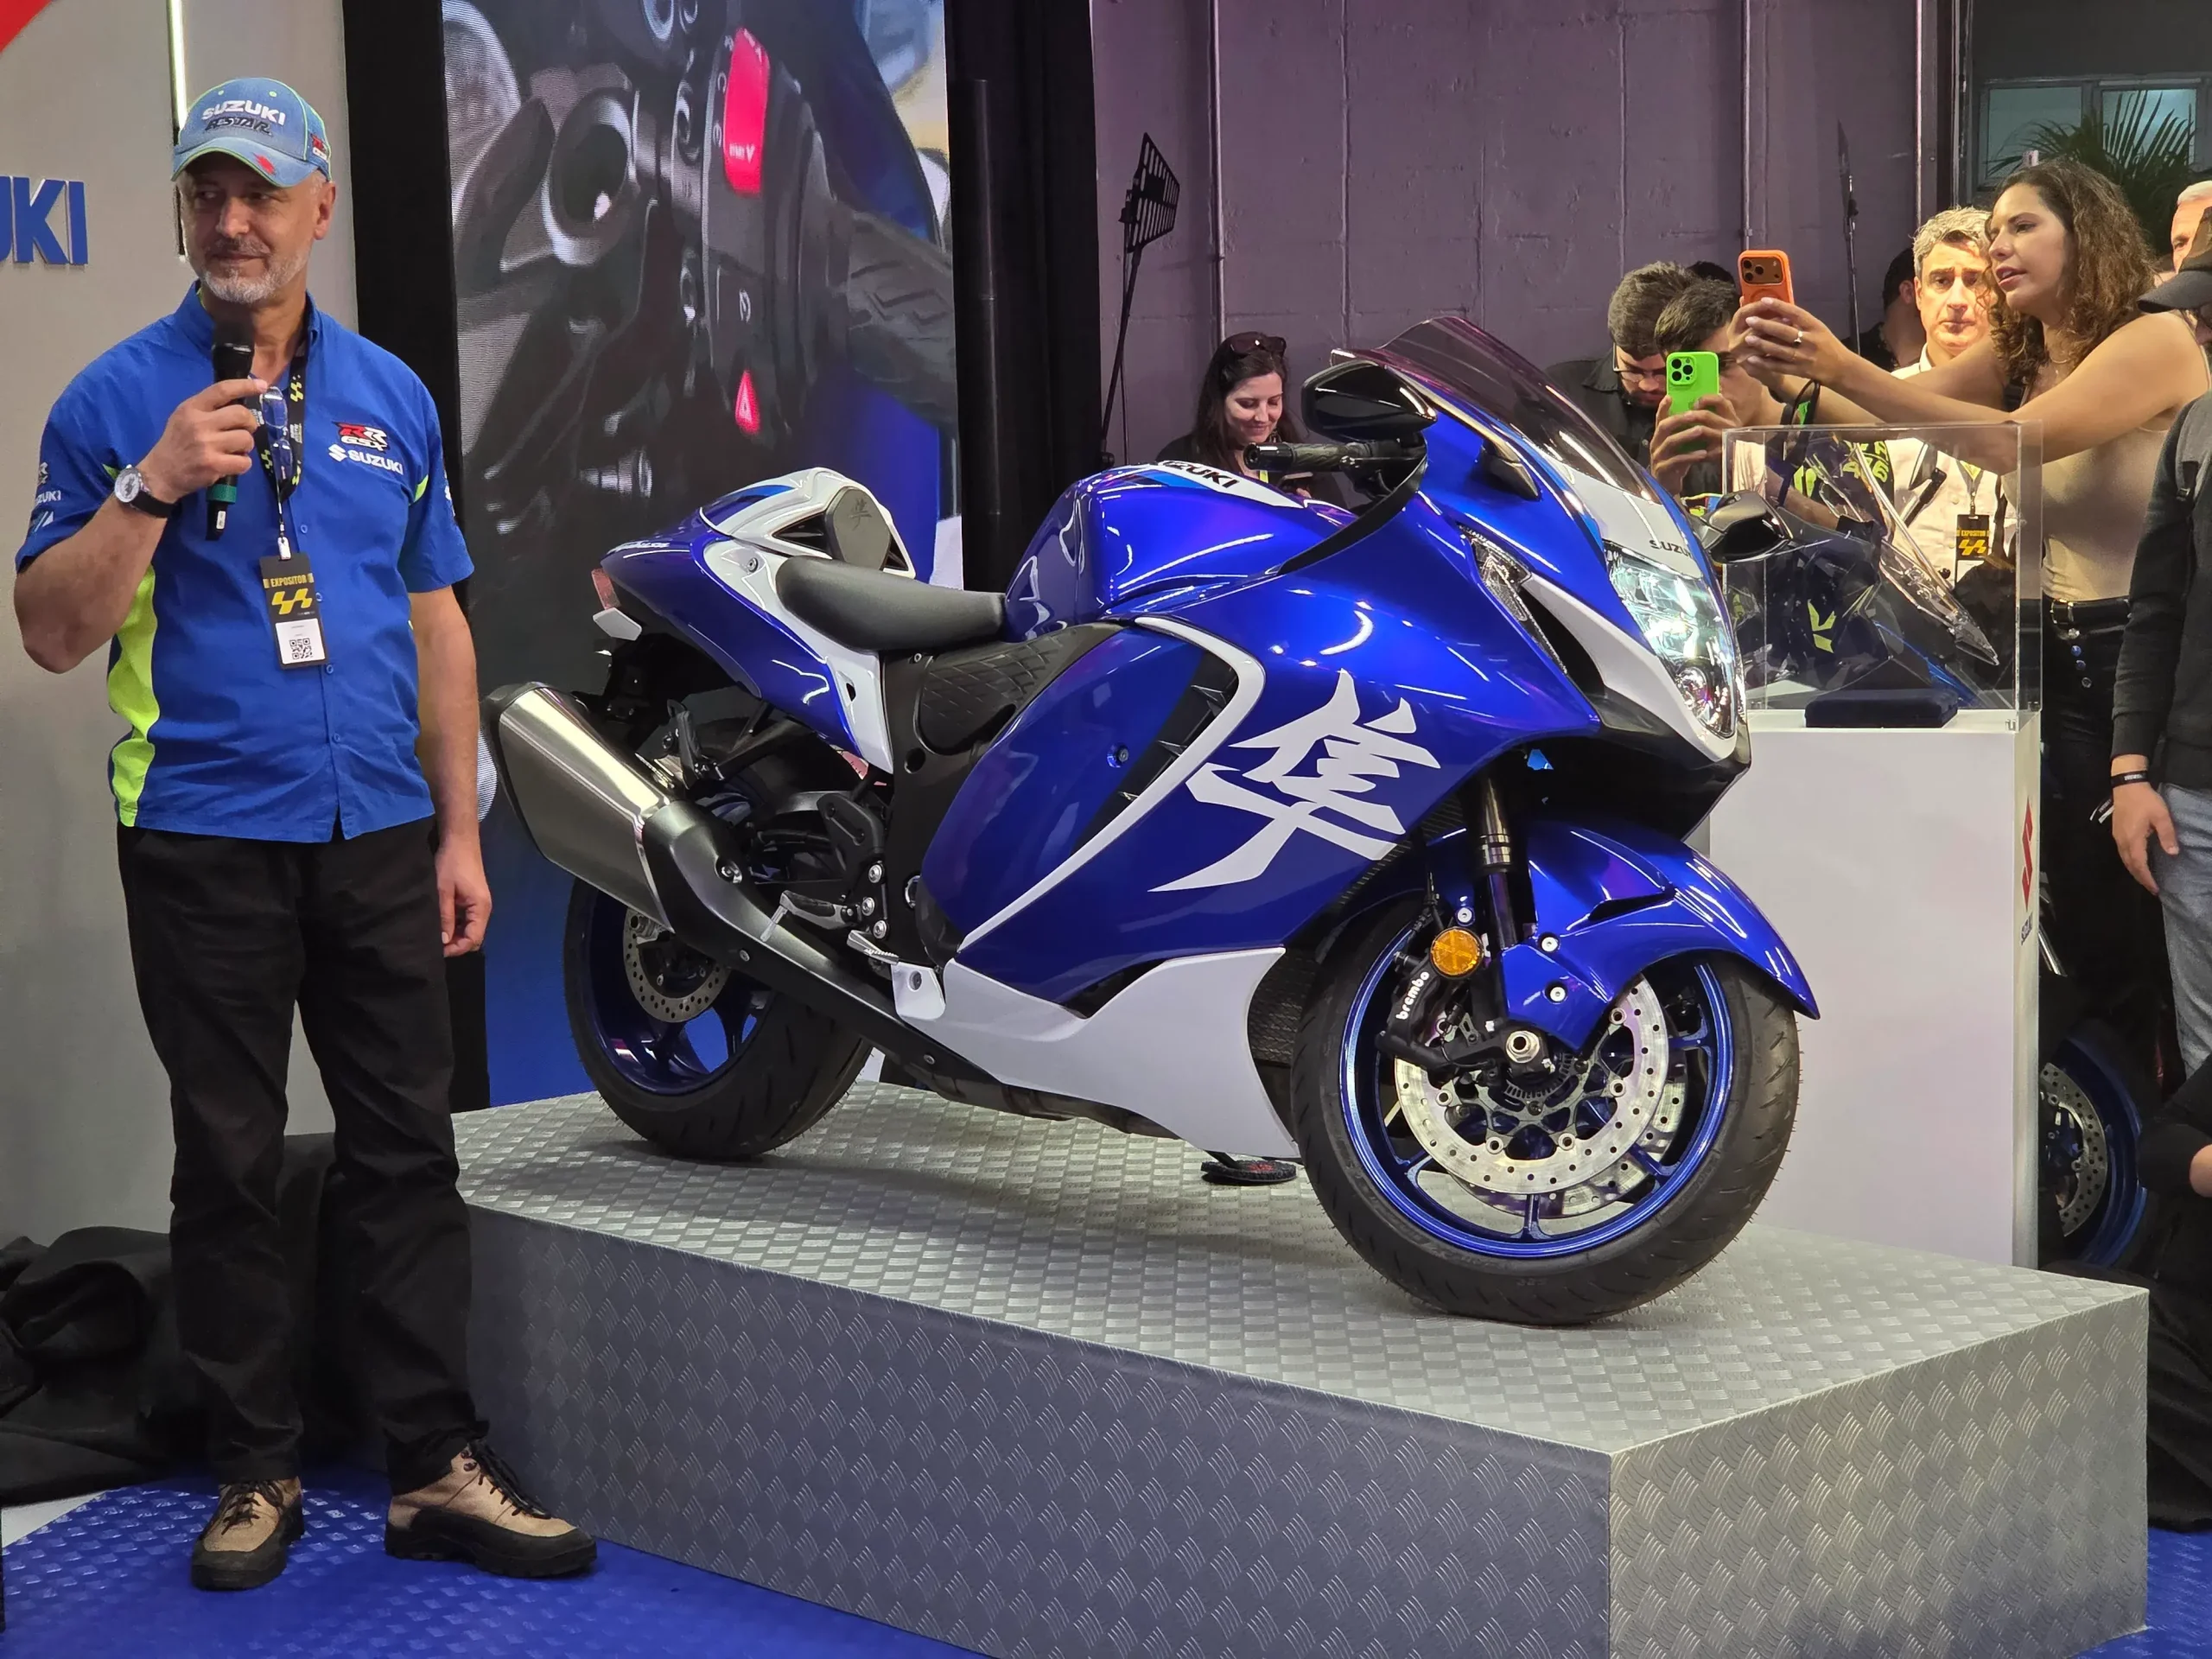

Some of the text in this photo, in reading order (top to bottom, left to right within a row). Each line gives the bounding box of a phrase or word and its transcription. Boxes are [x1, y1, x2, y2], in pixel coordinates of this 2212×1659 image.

[201, 99, 286, 126] SUZUKI
[347, 448, 404, 476] SUZUKI
[36, 489, 61, 504] ZUKI
[1649, 539, 1692, 560] SUZU
[270, 574, 308, 588] EXPOSITOR
[1395, 971, 1430, 1020] brembo
